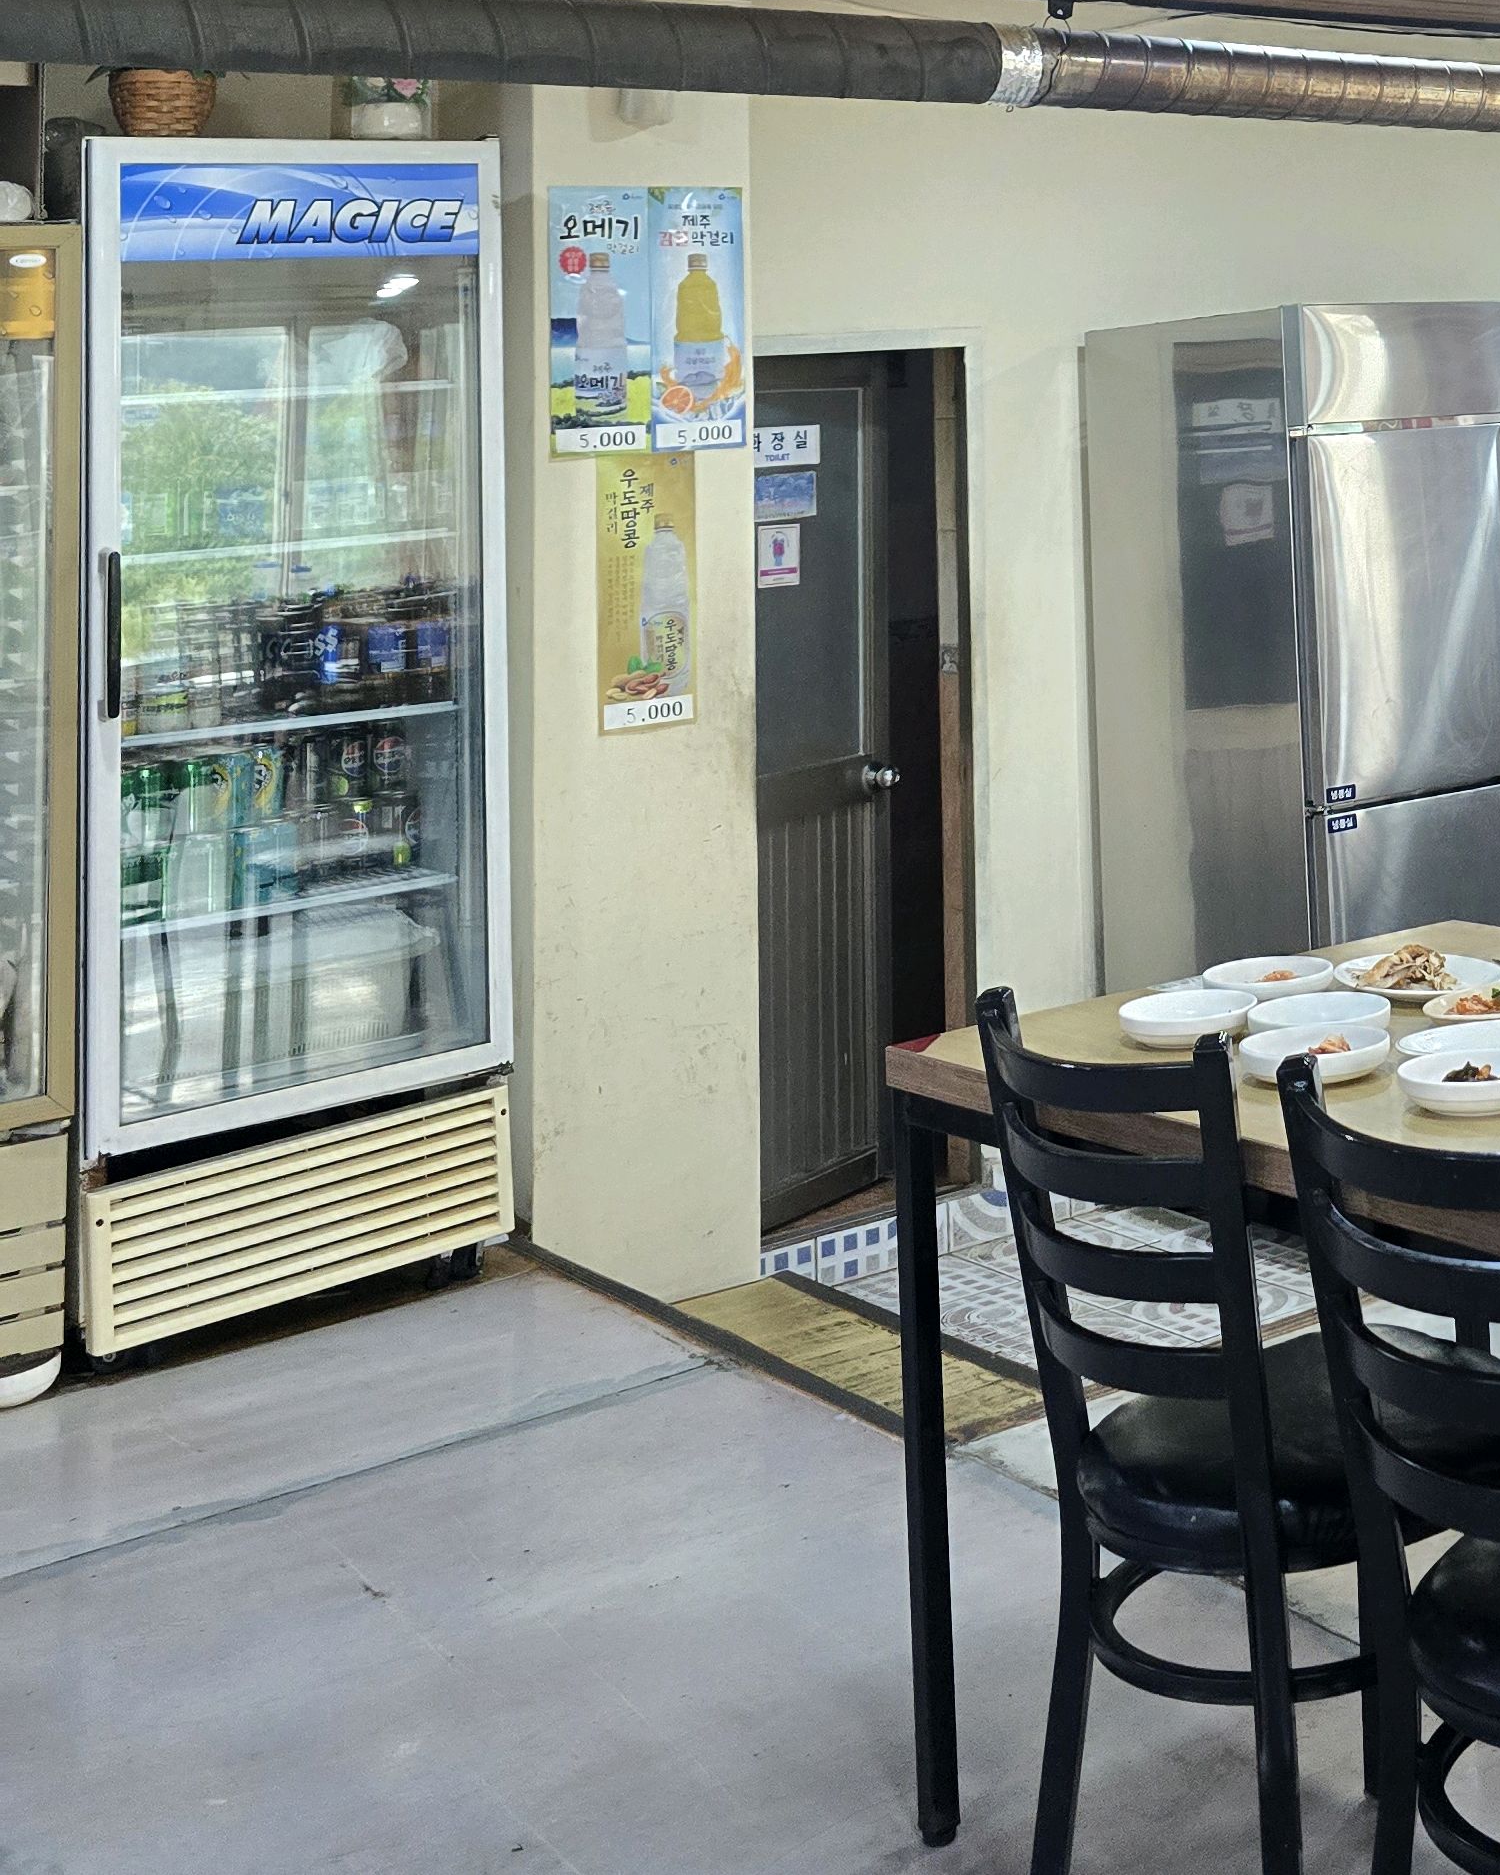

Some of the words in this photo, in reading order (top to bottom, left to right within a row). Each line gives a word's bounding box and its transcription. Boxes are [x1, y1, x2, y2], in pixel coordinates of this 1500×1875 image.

[237, 198, 464, 244] MAGICE
[559, 214, 639, 240] 오메기
[681, 214, 711, 229] 제주
[765, 453, 790, 462] TOILET
[620, 468, 641, 549] 우도땅콩
[640, 483, 655, 514] 제주
